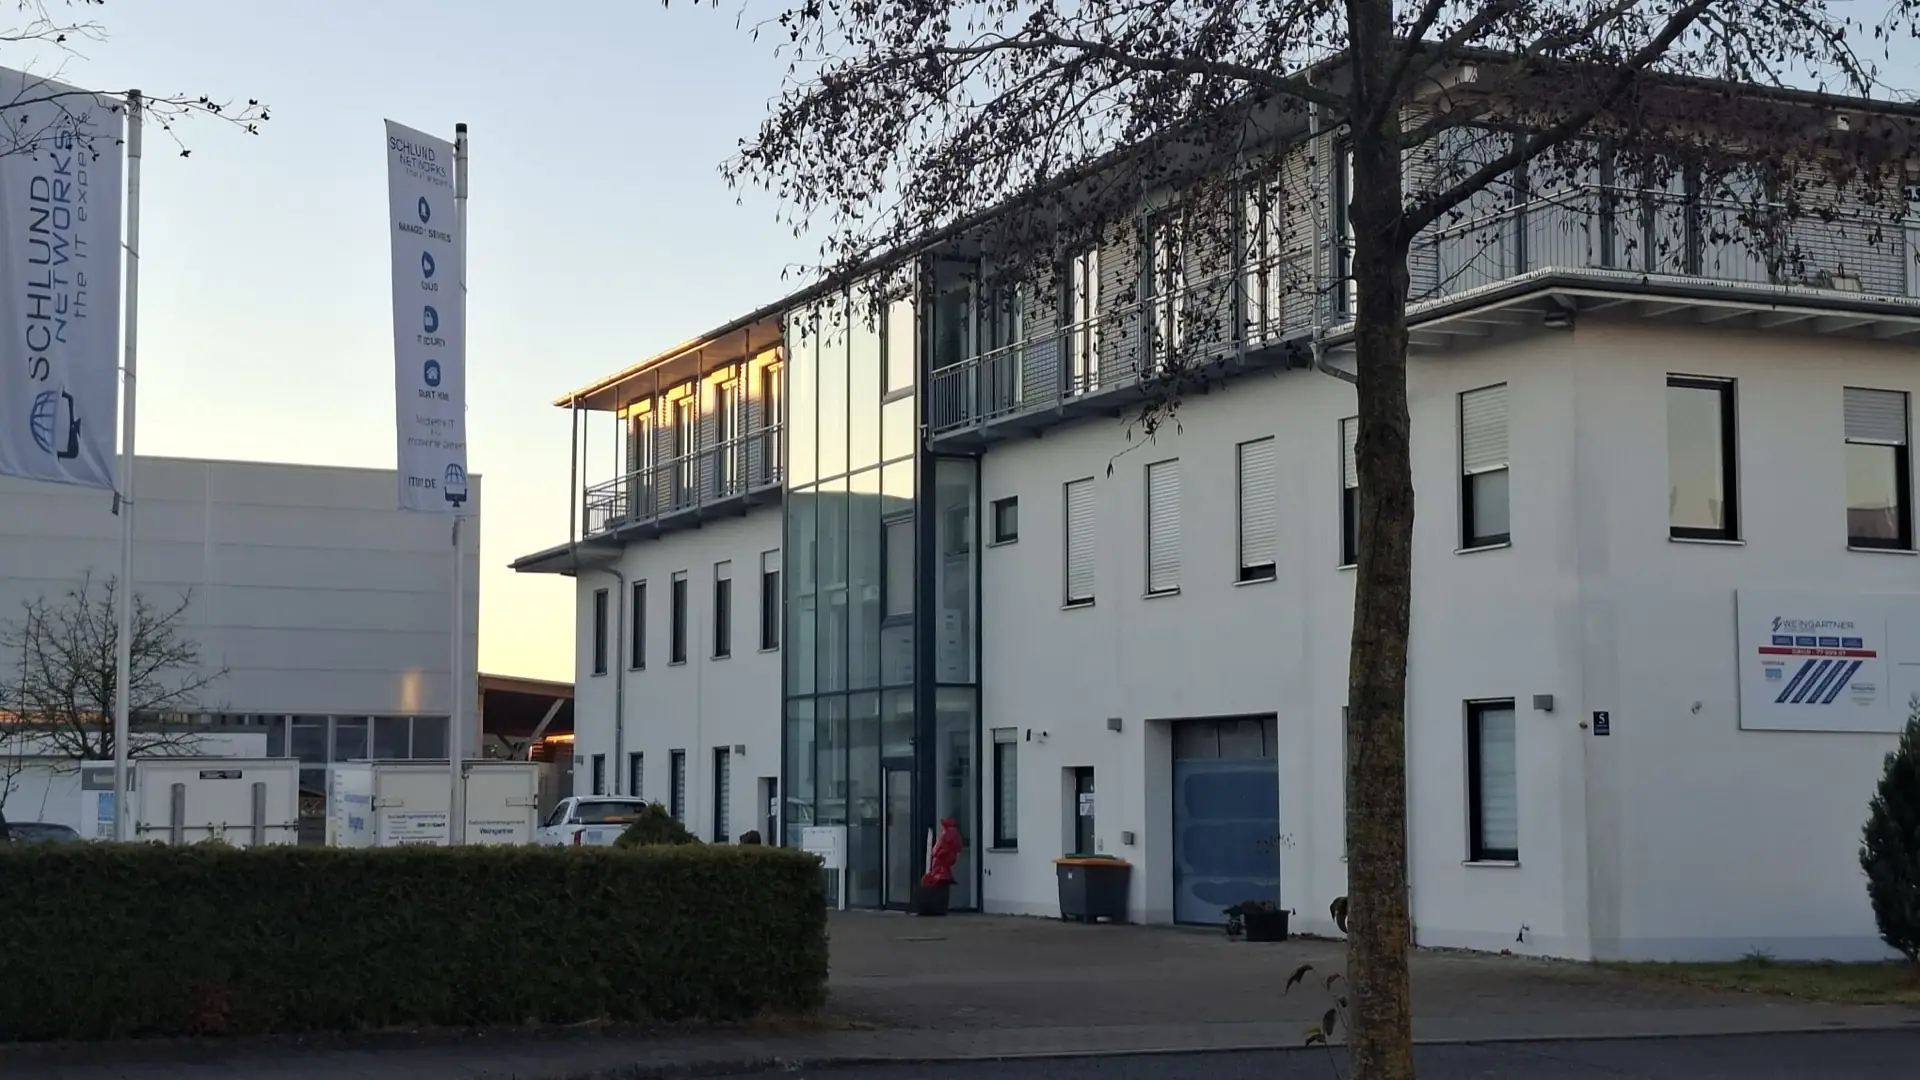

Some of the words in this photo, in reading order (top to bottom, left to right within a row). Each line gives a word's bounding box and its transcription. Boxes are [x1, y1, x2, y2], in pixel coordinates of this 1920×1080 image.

[389, 136, 436, 161] SCHLUND
[52, 127, 72, 344] NETWORKS
[74, 233, 88, 259] IT
[26, 175, 52, 382] SCHLUND
[73, 272, 88, 319] the
[1783, 619, 1855, 630] WEINGARTNER
[1598, 713, 1606, 724] 5
